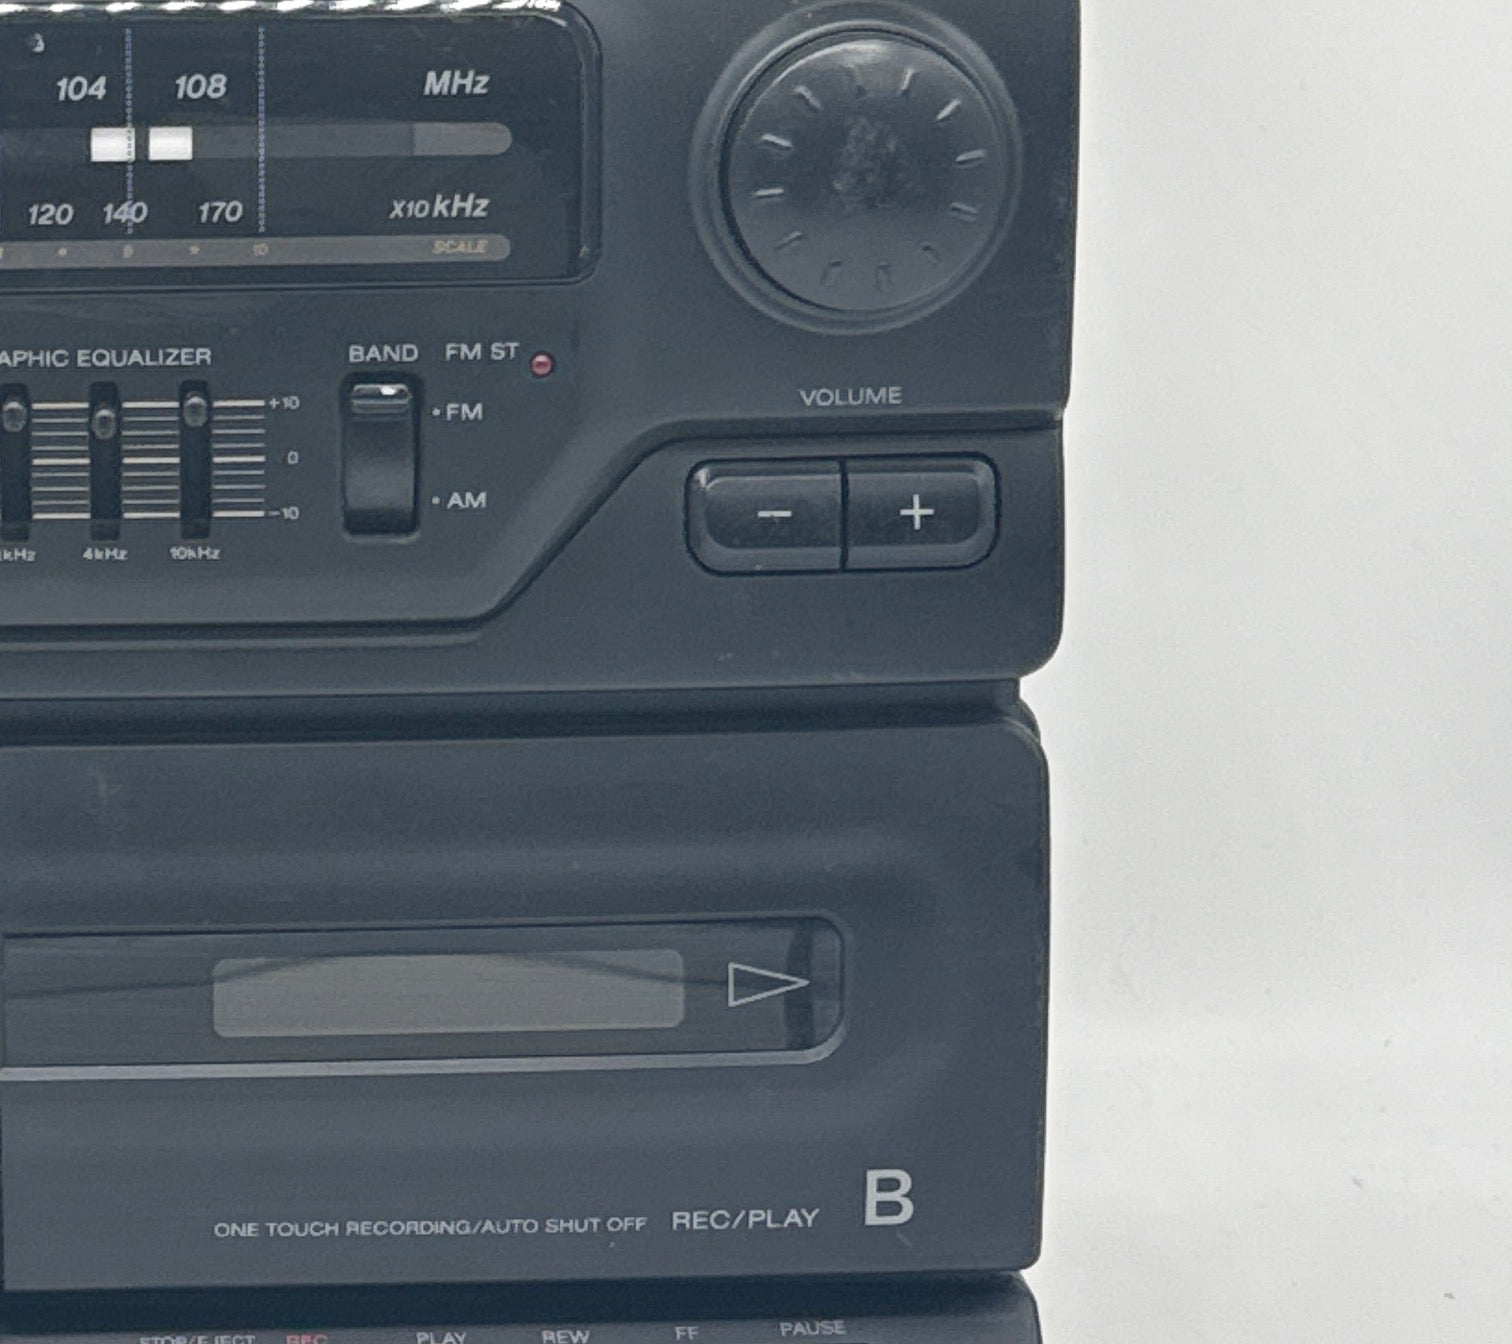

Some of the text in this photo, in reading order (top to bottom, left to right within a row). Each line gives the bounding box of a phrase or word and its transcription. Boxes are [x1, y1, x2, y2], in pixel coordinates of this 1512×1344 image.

[56, 75, 107, 102] 104
[174, 74, 227, 99] 108
[422, 70, 491, 97] MHz
[27, 202, 74, 225] 120
[103, 201, 148, 224] 140
[198, 200, 243, 223] 170
[432, 240, 488, 254] SCALE
[77, 348, 212, 367] EQUALIZER
[348, 344, 419, 363] BAND
[445, 342, 520, 361] FM ST
[799, 386, 903, 406] VOLUME
[446, 403, 483, 421] FM
[446, 492, 487, 509] AM
[82, 546, 128, 561] 4kHz
[169, 545, 221, 561] 10kHz
[864, 1168, 915, 1227] B
[213, 1216, 648, 1239] ONE TOUCH RECORDING/AUTO SHUT OFF
[672, 1209, 820, 1232] REC/PLAY
[541, 1329, 592, 1344] REW
[674, 1325, 700, 1341] FF
[779, 1320, 847, 1338] PAUSE
